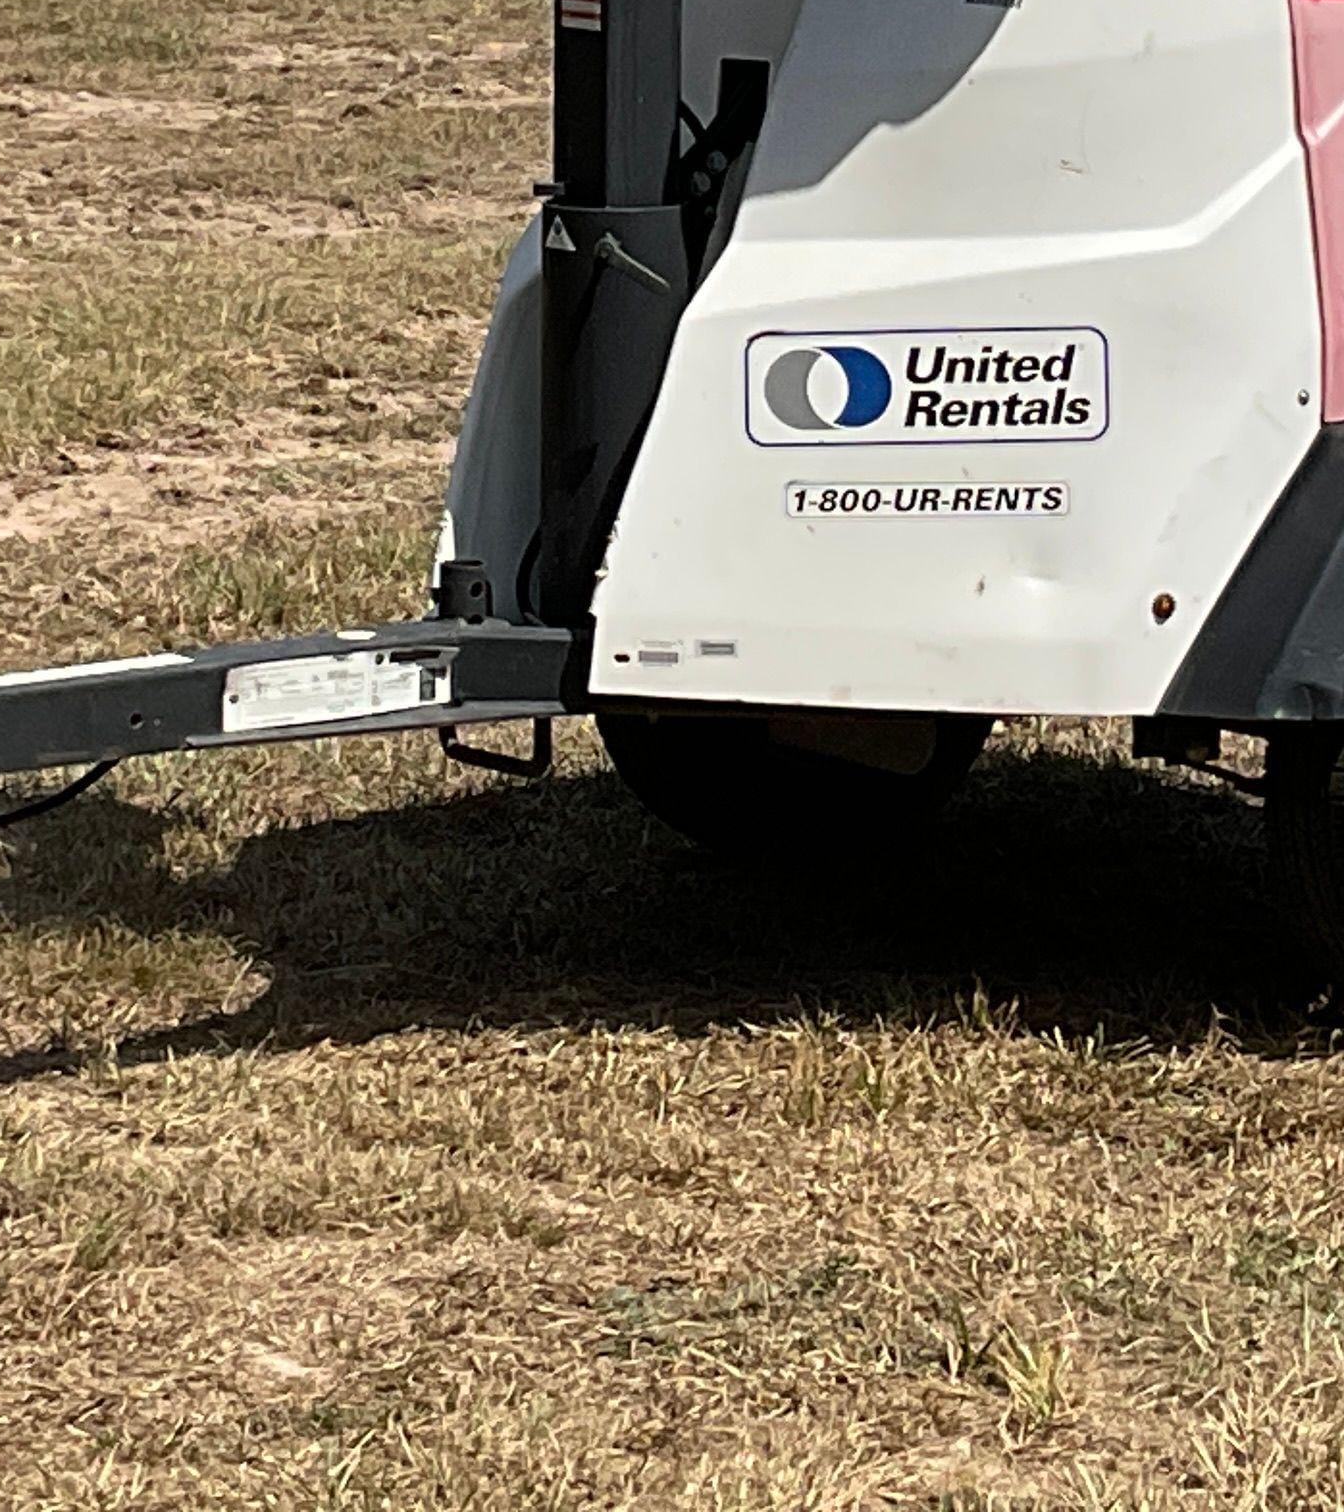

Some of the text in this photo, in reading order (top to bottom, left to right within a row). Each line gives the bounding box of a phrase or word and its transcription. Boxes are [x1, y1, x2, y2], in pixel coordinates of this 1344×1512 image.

[905, 345, 1076, 384] United
[904, 387, 1090, 428] Rentals
[793, 488, 1062, 512] 1-800-UR-RENTS
